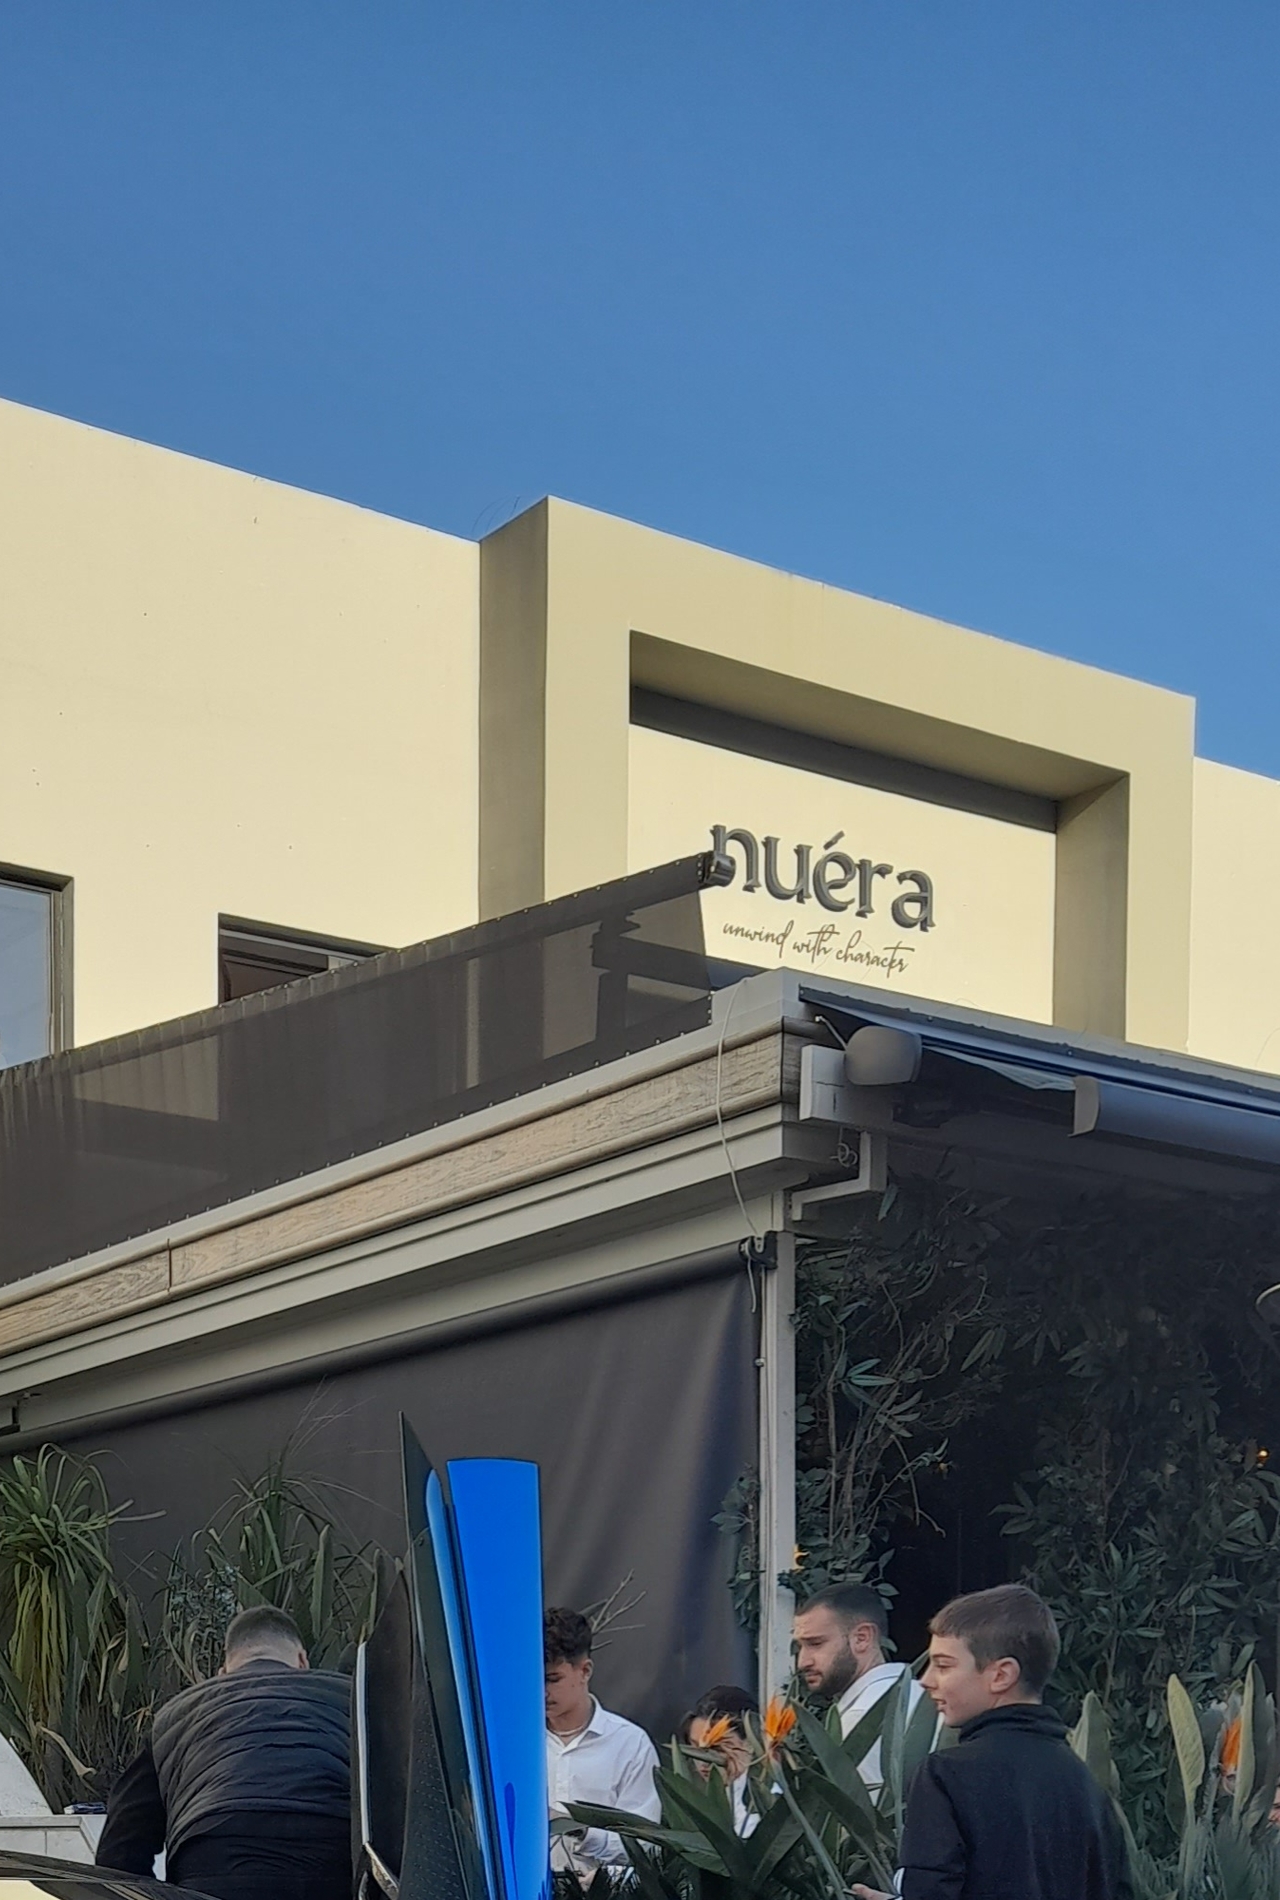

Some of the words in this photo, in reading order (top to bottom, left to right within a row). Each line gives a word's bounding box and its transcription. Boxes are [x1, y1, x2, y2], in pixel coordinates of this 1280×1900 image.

[710, 824, 936, 932] nuéra
[722, 920, 794, 959] unwind
[792, 924, 840, 963] with
